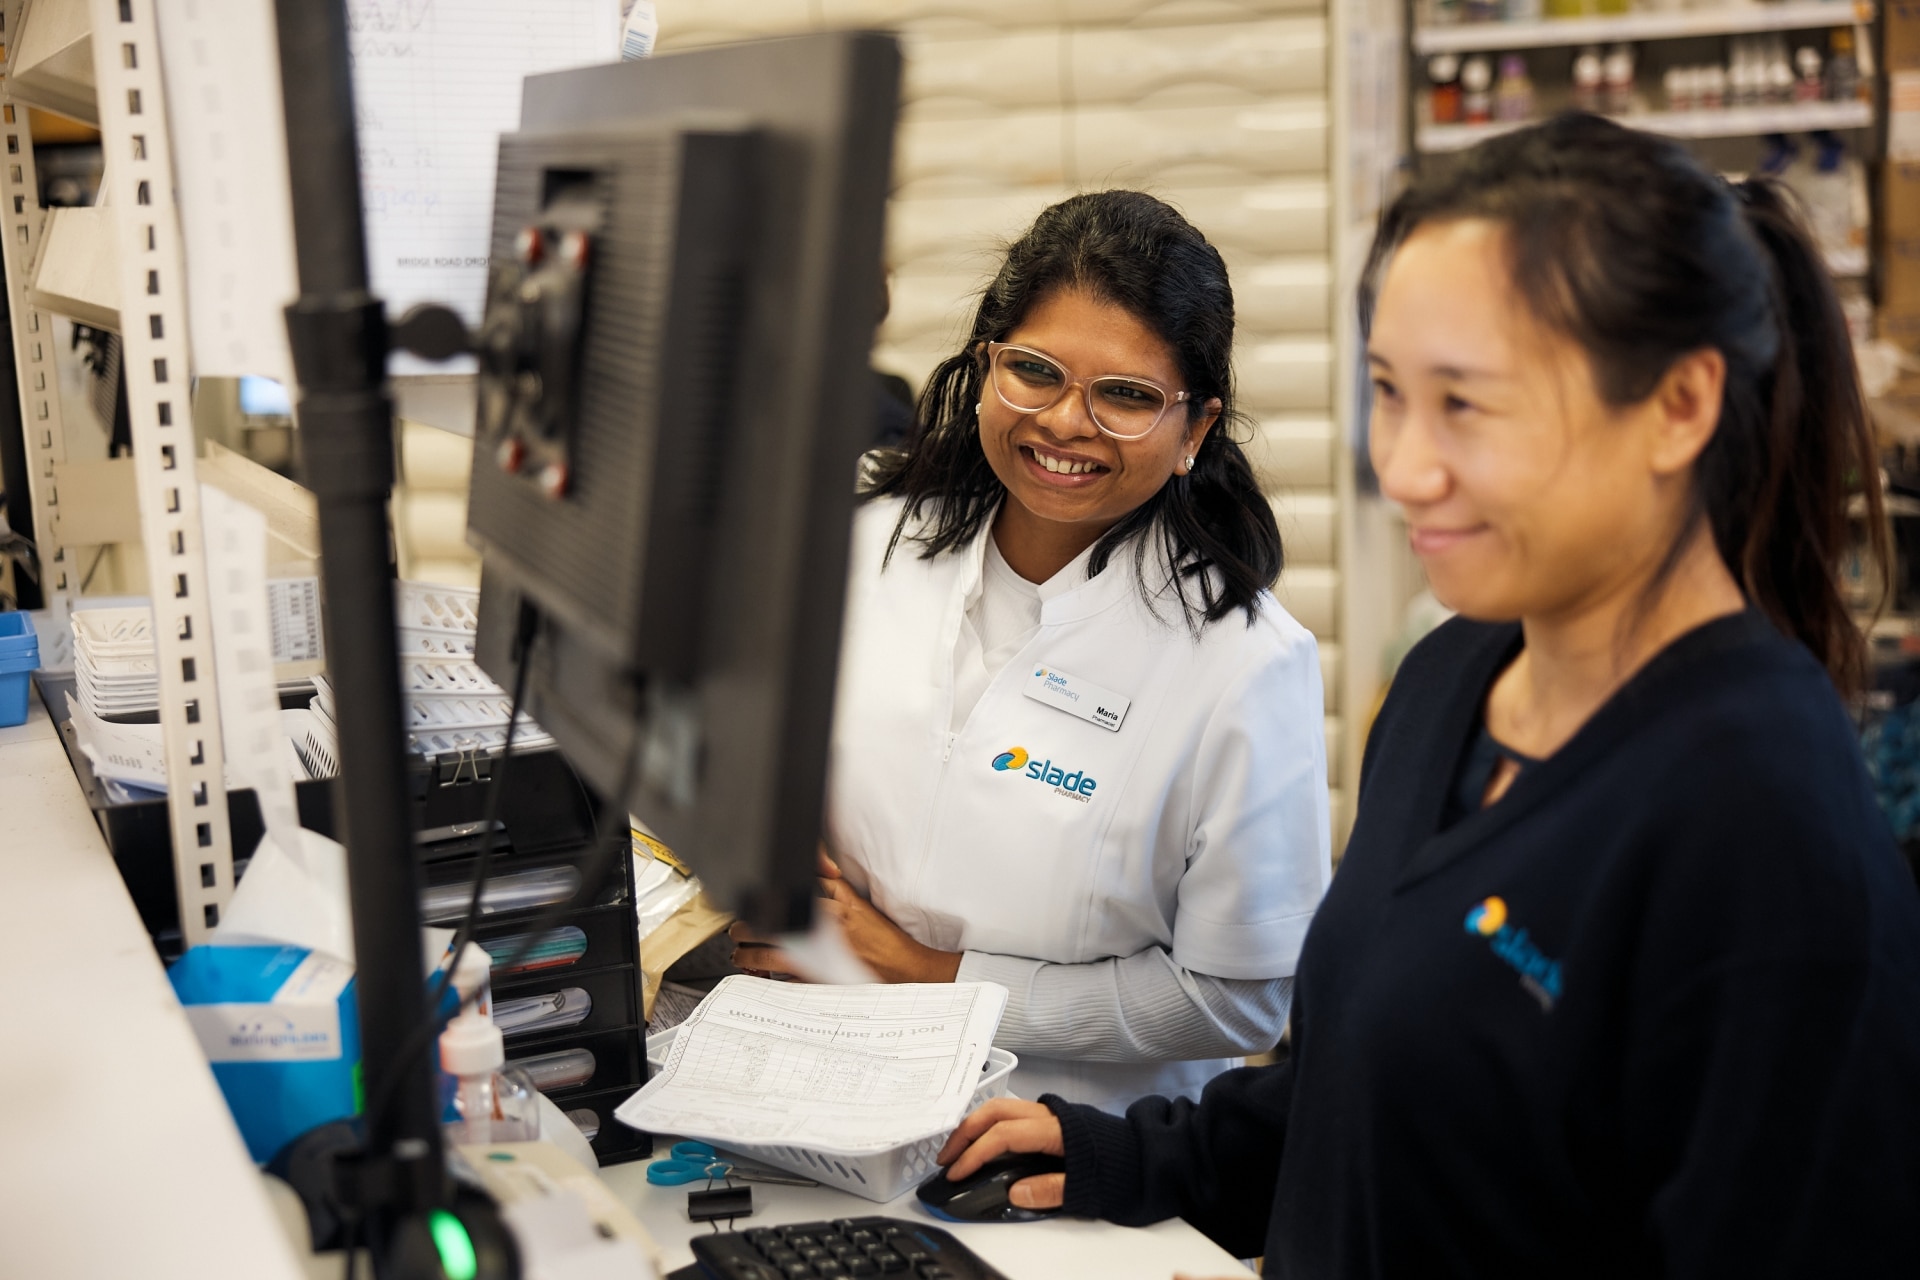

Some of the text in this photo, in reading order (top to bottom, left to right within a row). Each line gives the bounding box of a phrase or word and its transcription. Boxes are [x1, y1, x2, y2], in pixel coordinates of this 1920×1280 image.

[1047, 672, 1067, 687] Slade
[1043, 680, 1080, 702] Pharmacy
[1096, 706, 1119, 721] Maria
[1025, 759, 1097, 797] slade
[1053, 787, 1091, 804] PHARMACY
[728, 1009, 871, 1039] administration
[911, 1024, 945, 1036] Not
[876, 1030, 904, 1039] for
